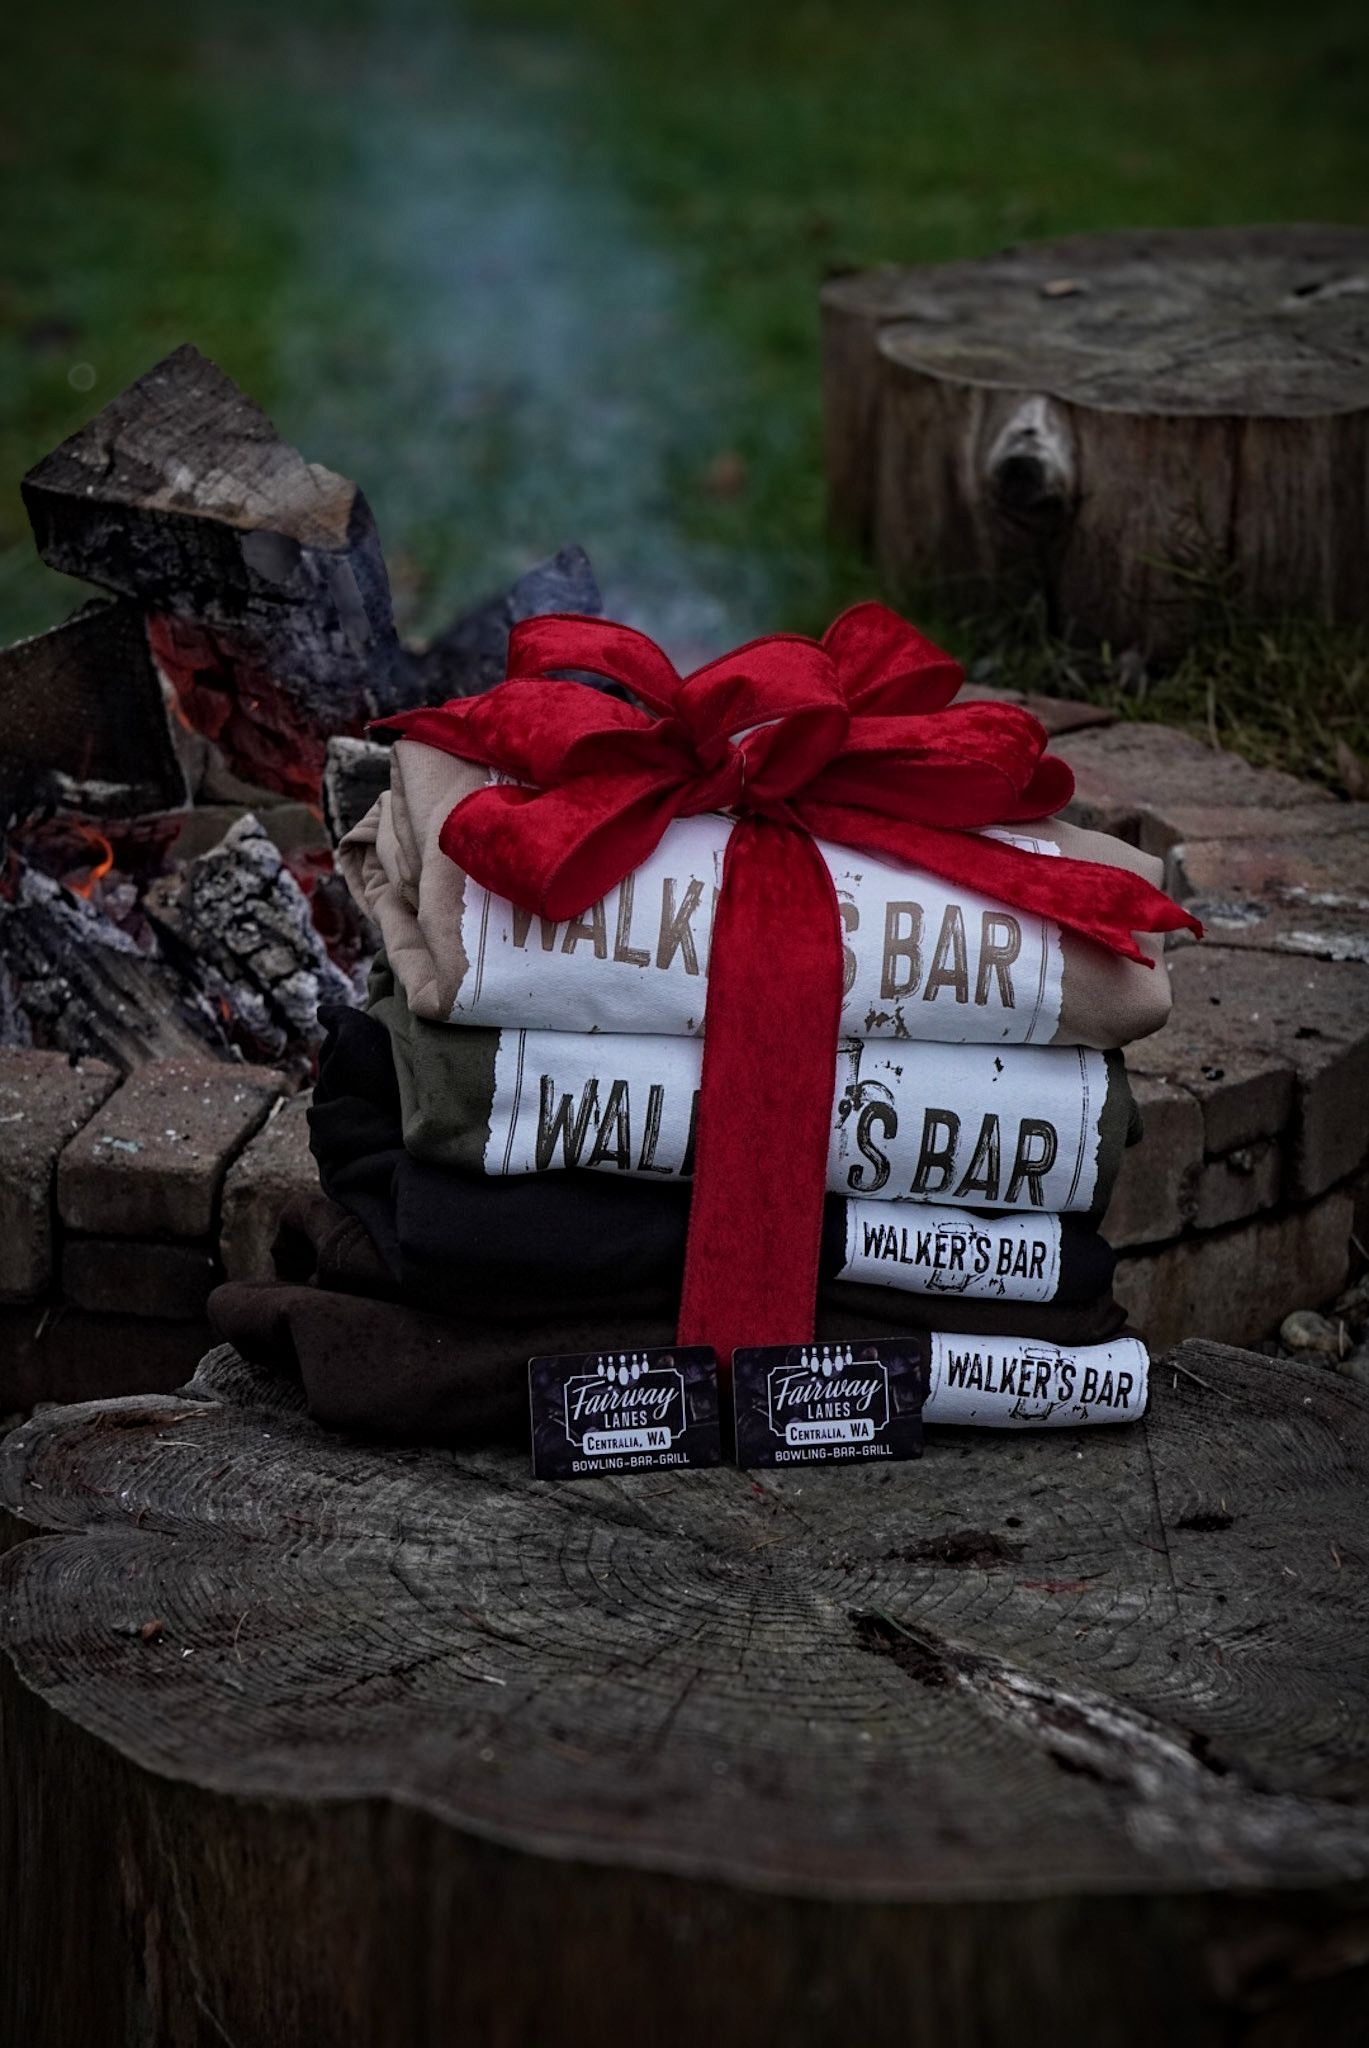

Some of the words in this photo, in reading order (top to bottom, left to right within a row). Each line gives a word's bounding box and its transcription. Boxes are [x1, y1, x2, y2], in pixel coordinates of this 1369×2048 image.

[880, 901, 1022, 1009] BAR
[910, 1108, 1058, 1206] BAR
[863, 1221, 991, 1274] WALKER'S
[996, 1238, 1047, 1279] BAR
[774, 1371, 883, 1411] Fairway
[948, 1350, 1077, 1402] WALKER'S
[1079, 1366, 1134, 1408] BAR
[570, 1380, 680, 1421] Fairway
[807, 1401, 851, 1419] LANES
[604, 1410, 648, 1428] LANES
[850, 1422, 869, 1437] WA
[647, 1431, 666, 1446] WA
[775, 1444, 893, 1462] BOWLING-BAR-GRILL
[572, 1452, 690, 1472] BOWLING-BAR-GRILL
